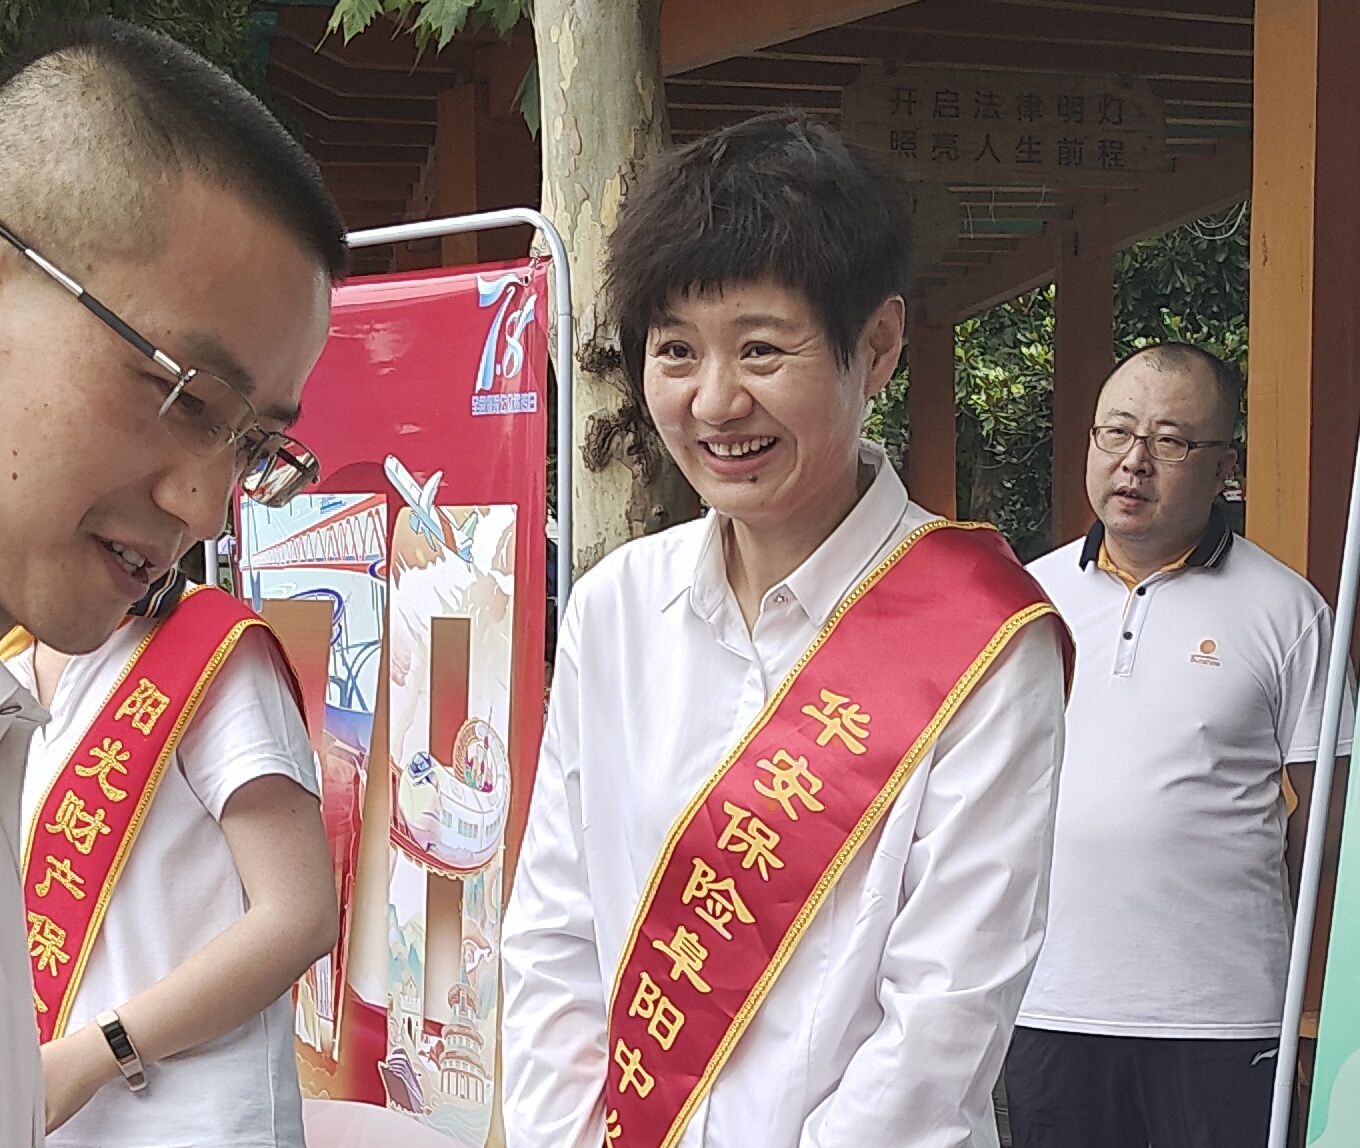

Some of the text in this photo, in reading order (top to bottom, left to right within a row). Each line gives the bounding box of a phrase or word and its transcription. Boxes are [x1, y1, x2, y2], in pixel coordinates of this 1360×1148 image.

[890, 87, 1126, 126] 开启法律明灯
[890, 129, 1126, 170] 照亮人生前程
[28, 677, 172, 1013] 阳光财产保
